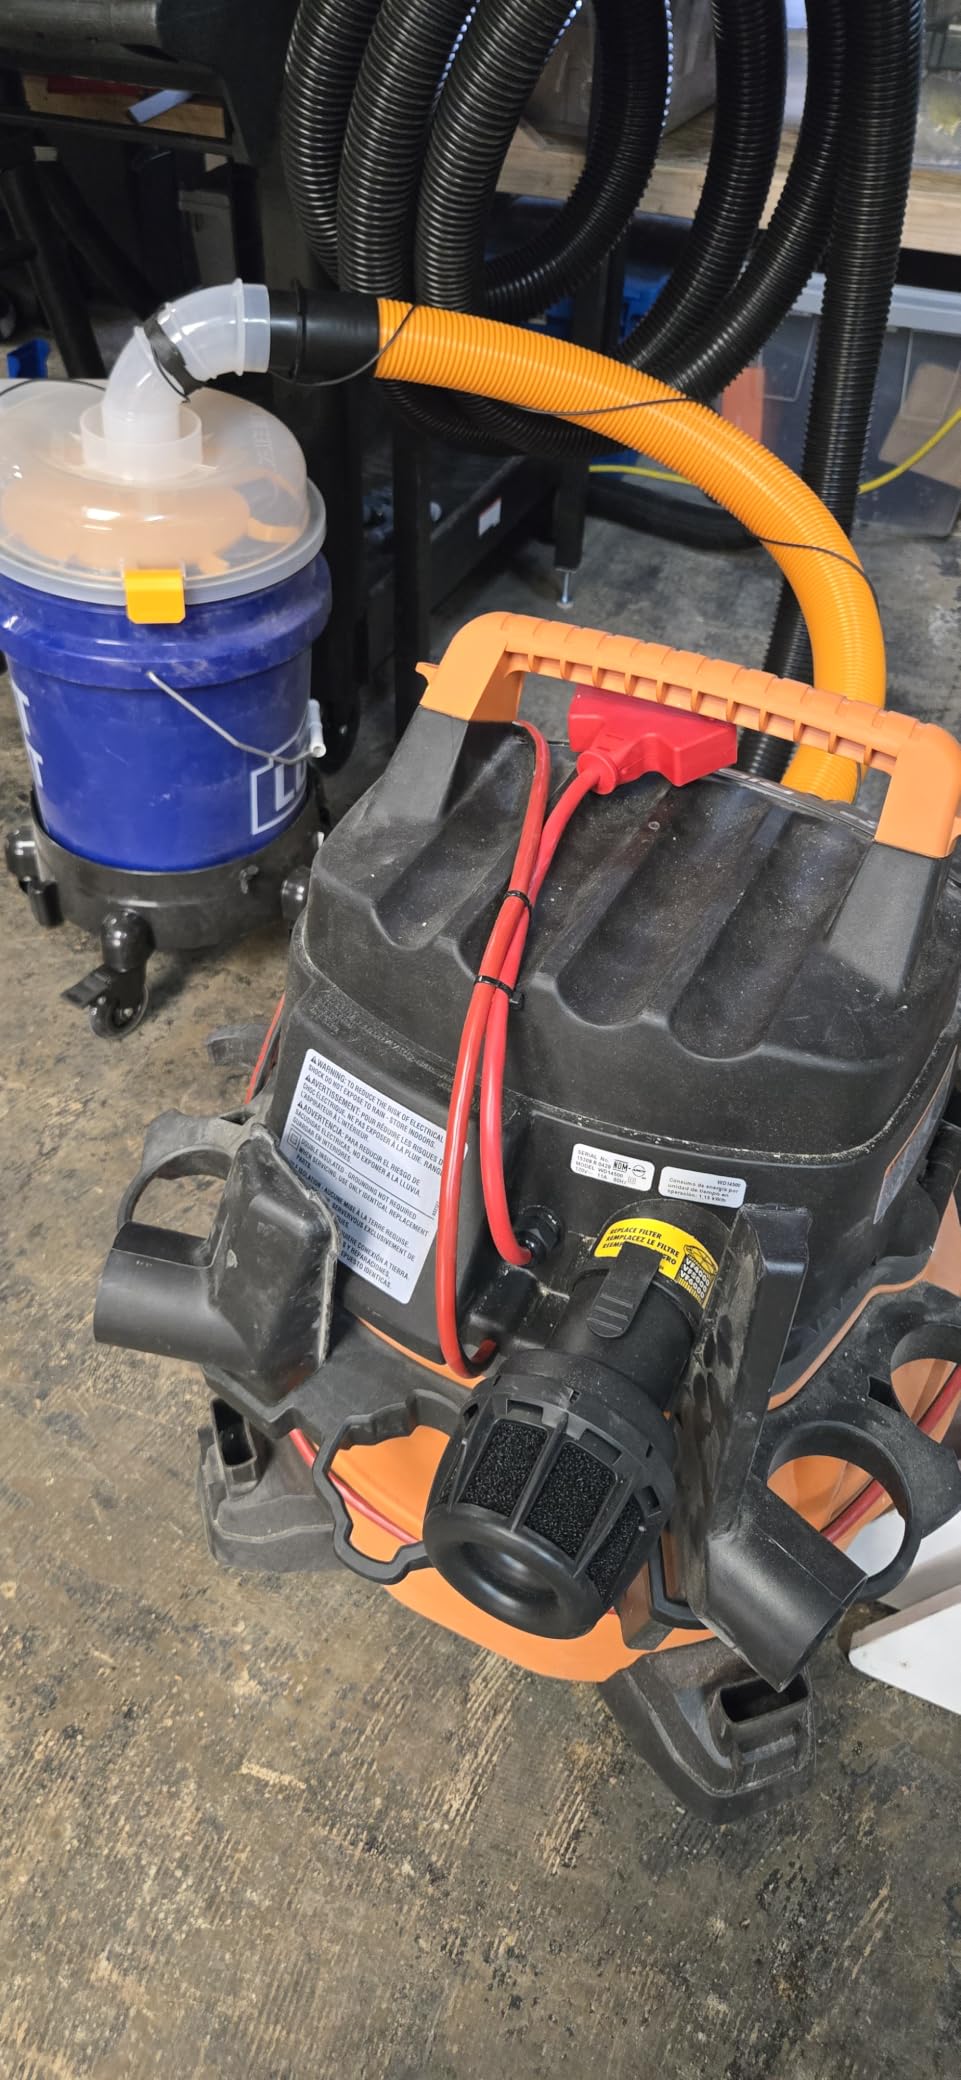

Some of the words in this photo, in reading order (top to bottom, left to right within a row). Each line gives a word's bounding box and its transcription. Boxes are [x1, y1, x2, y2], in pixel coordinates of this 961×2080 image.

[308, 1064, 324, 1079] SHOCK
[324, 1075, 332, 1084] DO
[332, 1080, 343, 1091] NOT
[343, 1087, 363, 1105] EXPOSE
[363, 1100, 371, 1110] TO
[371, 1105, 385, 1118] RAIN
[388, 1116, 407, 1132] STORE
[317, 1059, 346, 1083] WARNING:
[347, 1079, 354, 1089] TO
[354, 1084, 375, 1102] REDUCE
[376, 1098, 387, 1109] THE
[387, 1105, 400, 1117] RISK
[401, 1113, 410, 1121] OF
[409, 1118, 443, 1142] ELECTRICAL
[311, 1078, 360, 1115] AVERTISSEMENT:
[360, 1111, 376, 1125] POUR
[400, 1136, 412, 1147] LES
[412, 1143, 437, 1162] RISQUES
[302, 1104, 344, 1137] ADVERTENCIA:
[344, 1133, 358, 1147] PARA
[359, 1143, 382, 1162] REDUCIR
[382, 1158, 389, 1167] EL
[390, 1163, 411, 1180] RIESGO
[411, 1176, 420, 1186] DE
[314, 1133, 321, 1141] EN
[346, 1113, 354, 1122] NE
[354, 1118, 365, 1129] PAS
[365, 1125, 390, 1145] EXPOSER
[395, 1143, 403, 1153] LA
[423, 1160, 442, 1175] RANG
[352, 1149, 360, 1159] NO
[360, 1155, 386, 1175] EXPONER
[390, 1174, 398, 1183] LA
[576, 1161, 595, 1170] MODEL
[598, 1168, 624, 1178] WD14500
[578, 1150, 598, 1160] SERIAL
[318, 1151, 344, 1173] INSULATED
[347, 1171, 377, 1195] GROUNDING
[377, 1191, 389, 1202] NOT
[389, 1199, 416, 1219] REQUIRED
[338, 1175, 348, 1186] USE
[348, 1182, 362, 1194] ONLY
[361, 1191, 387, 1213] IDENTICAL
[388, 1209, 429, 1237] REPLACEMENT
[343, 1200, 356, 1213] MISE
[360, 1212, 367, 1221] LA
[368, 1217, 384, 1232] TERRE
[363, 1224, 406, 1256] EXCLUSIVEMENT
[407, 1252, 415, 1262] DE
[606, 1234, 645, 1242] REMPLACEZ
[657, 1242, 680, 1258] FILTRE
[639, 1228, 662, 1240] FILTER
[340, 1249, 363, 1269] EPUESTO
[383, 1259, 388, 1267] A
[389, 1262, 408, 1280] TIERRA
[686, 1257, 710, 1286] VF4000
